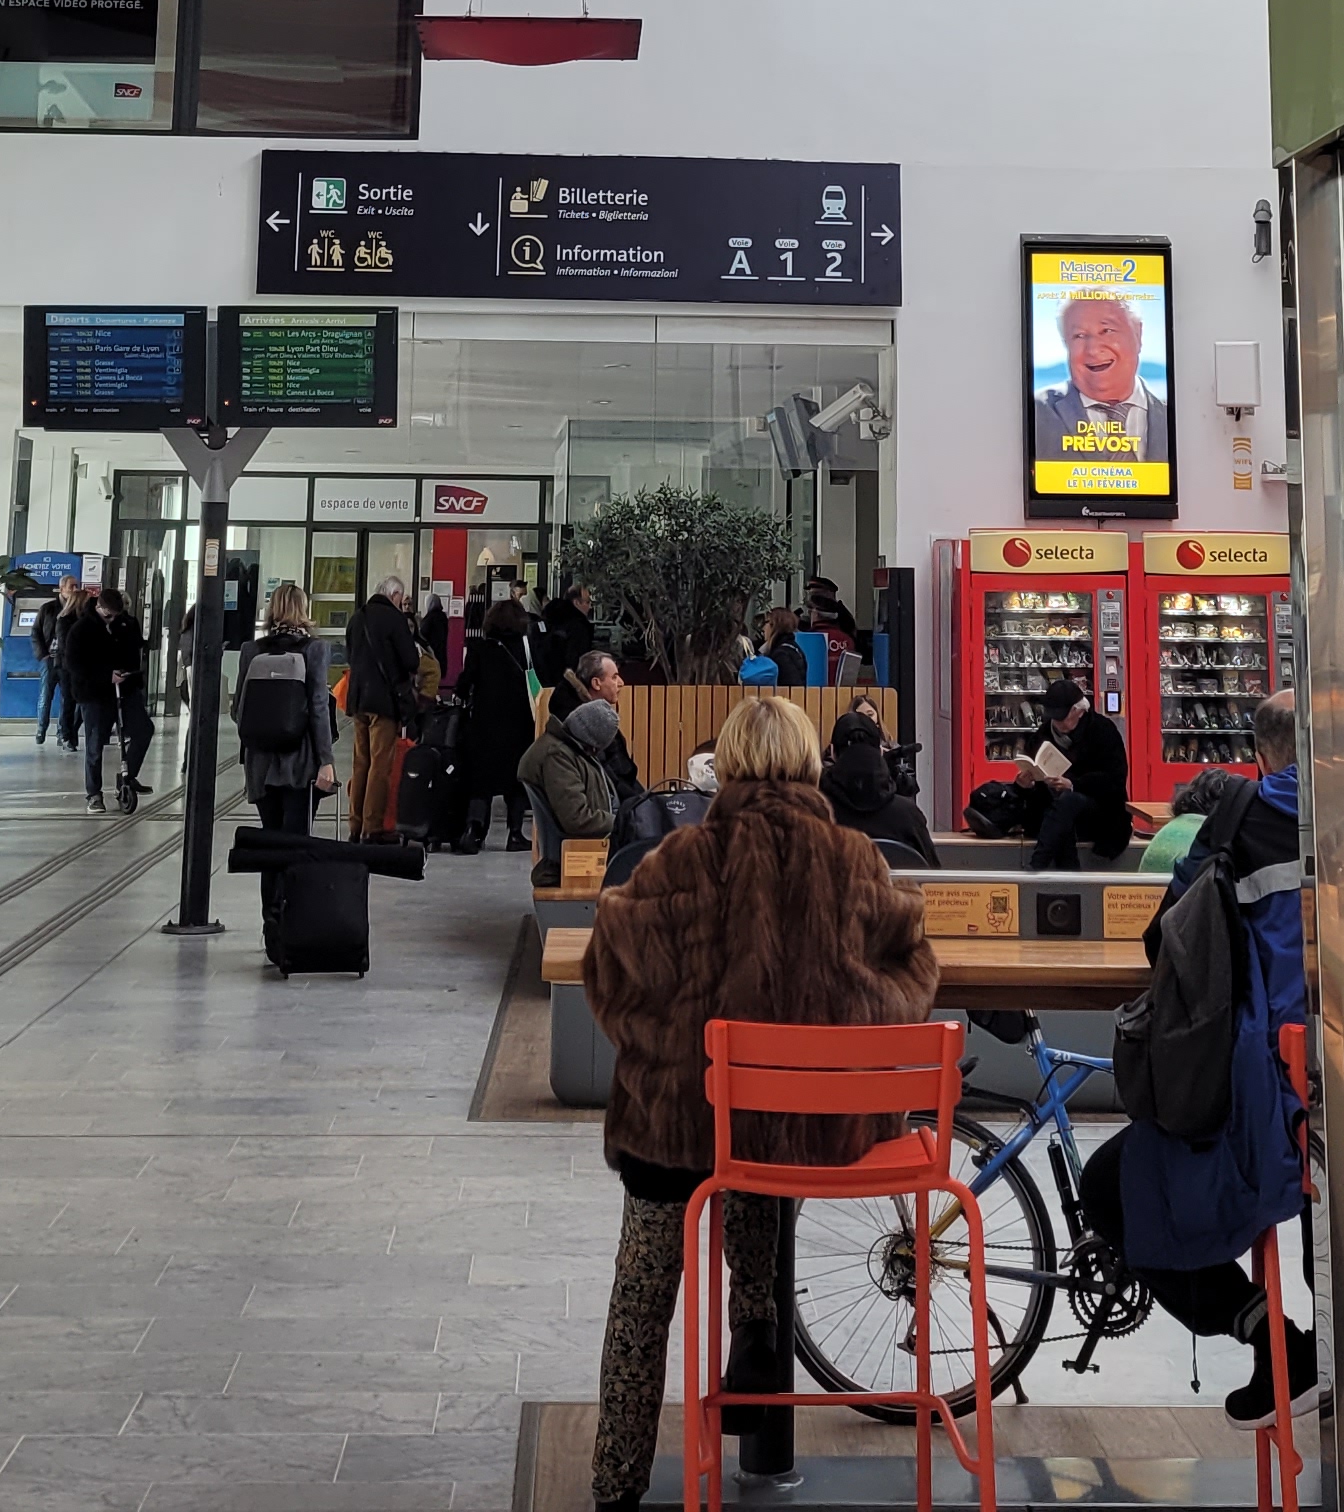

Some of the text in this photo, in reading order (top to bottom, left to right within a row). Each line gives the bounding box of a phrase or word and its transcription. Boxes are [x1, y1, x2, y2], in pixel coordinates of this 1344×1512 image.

[8, 0, 50, 7] ESPACE
[91, 0, 144, 9] PROTÉGÉ.
[358, 183, 413, 201] Sortie
[558, 188, 648, 205] Billetterie
[357, 206, 414, 216] Exit Uscita
[558, 210, 648, 221] Tickets Biglietteria
[320, 230, 335, 238] WC
[368, 231, 383, 239] WC
[556, 244, 664, 263] Information
[729, 250, 752, 275] A
[779, 251, 793, 276] 1
[825, 252, 842, 277] 2
[1060, 261, 1113, 272] Maison
[556, 266, 679, 278] Information Informazioni
[1123, 259, 1136, 282] 2
[1061, 273, 1123, 281] RETRAITE
[244, 316, 285, 324] Arrivées
[323, 330, 363, 338] Draguignan
[143, 345, 160, 353] Lyon
[287, 345, 304, 353] Lyon
[1077, 420, 1126, 434] DANIEL
[1062, 433, 1142, 452] PRÉVOST
[1072, 466, 1133, 476] AU CINÉMA
[1097, 477, 1138, 488] FÉVRIER
[320, 497, 409, 510] espace de vente
[436, 496, 485, 511] SNCF
[1035, 544, 1094, 561] selecta
[1208, 547, 1268, 564] selecta
[938, 898, 969, 908] précieux
[1121, 901, 1153, 911] précieux
